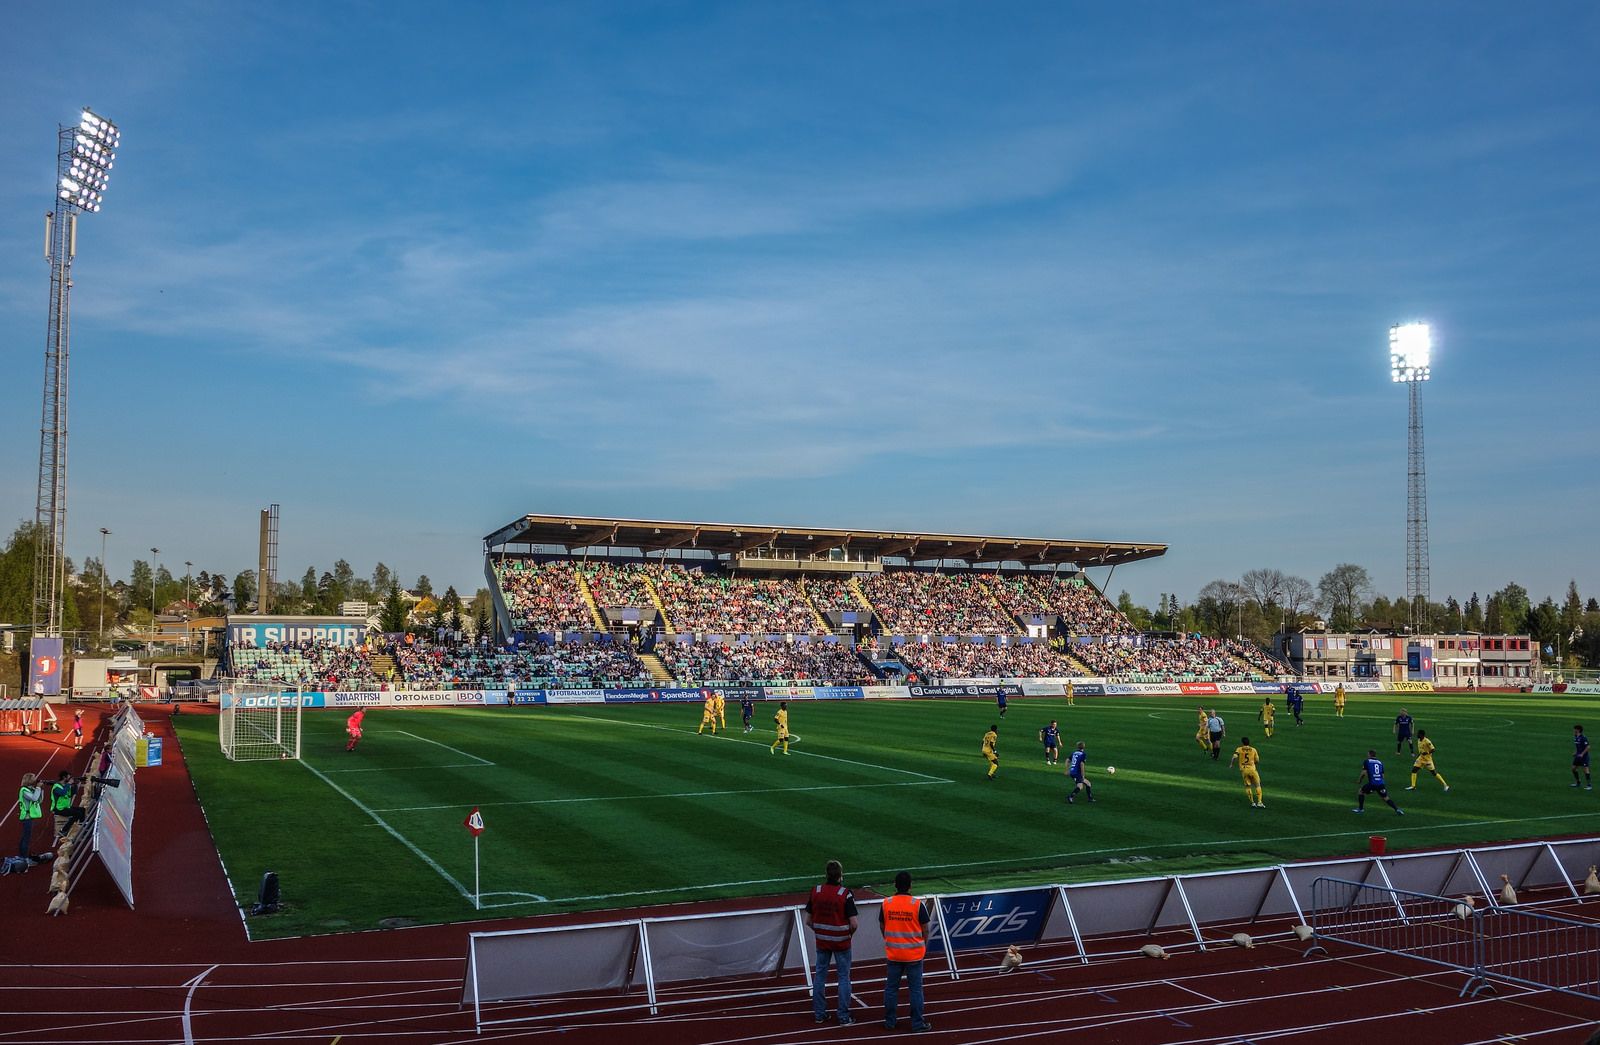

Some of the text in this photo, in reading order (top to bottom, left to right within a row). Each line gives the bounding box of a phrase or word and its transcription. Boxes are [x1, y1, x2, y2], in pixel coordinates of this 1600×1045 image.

[265, 627, 366, 648] SUPPORT
[41, 659, 50, 674] 1
[943, 687, 964, 695] Digital
[979, 686, 997, 694] Canal
[335, 693, 380, 701] SMARTFISH
[460, 692, 483, 700] BDO
[661, 691, 700, 699] SpareBank
[1374, 763, 1380, 775] 8
